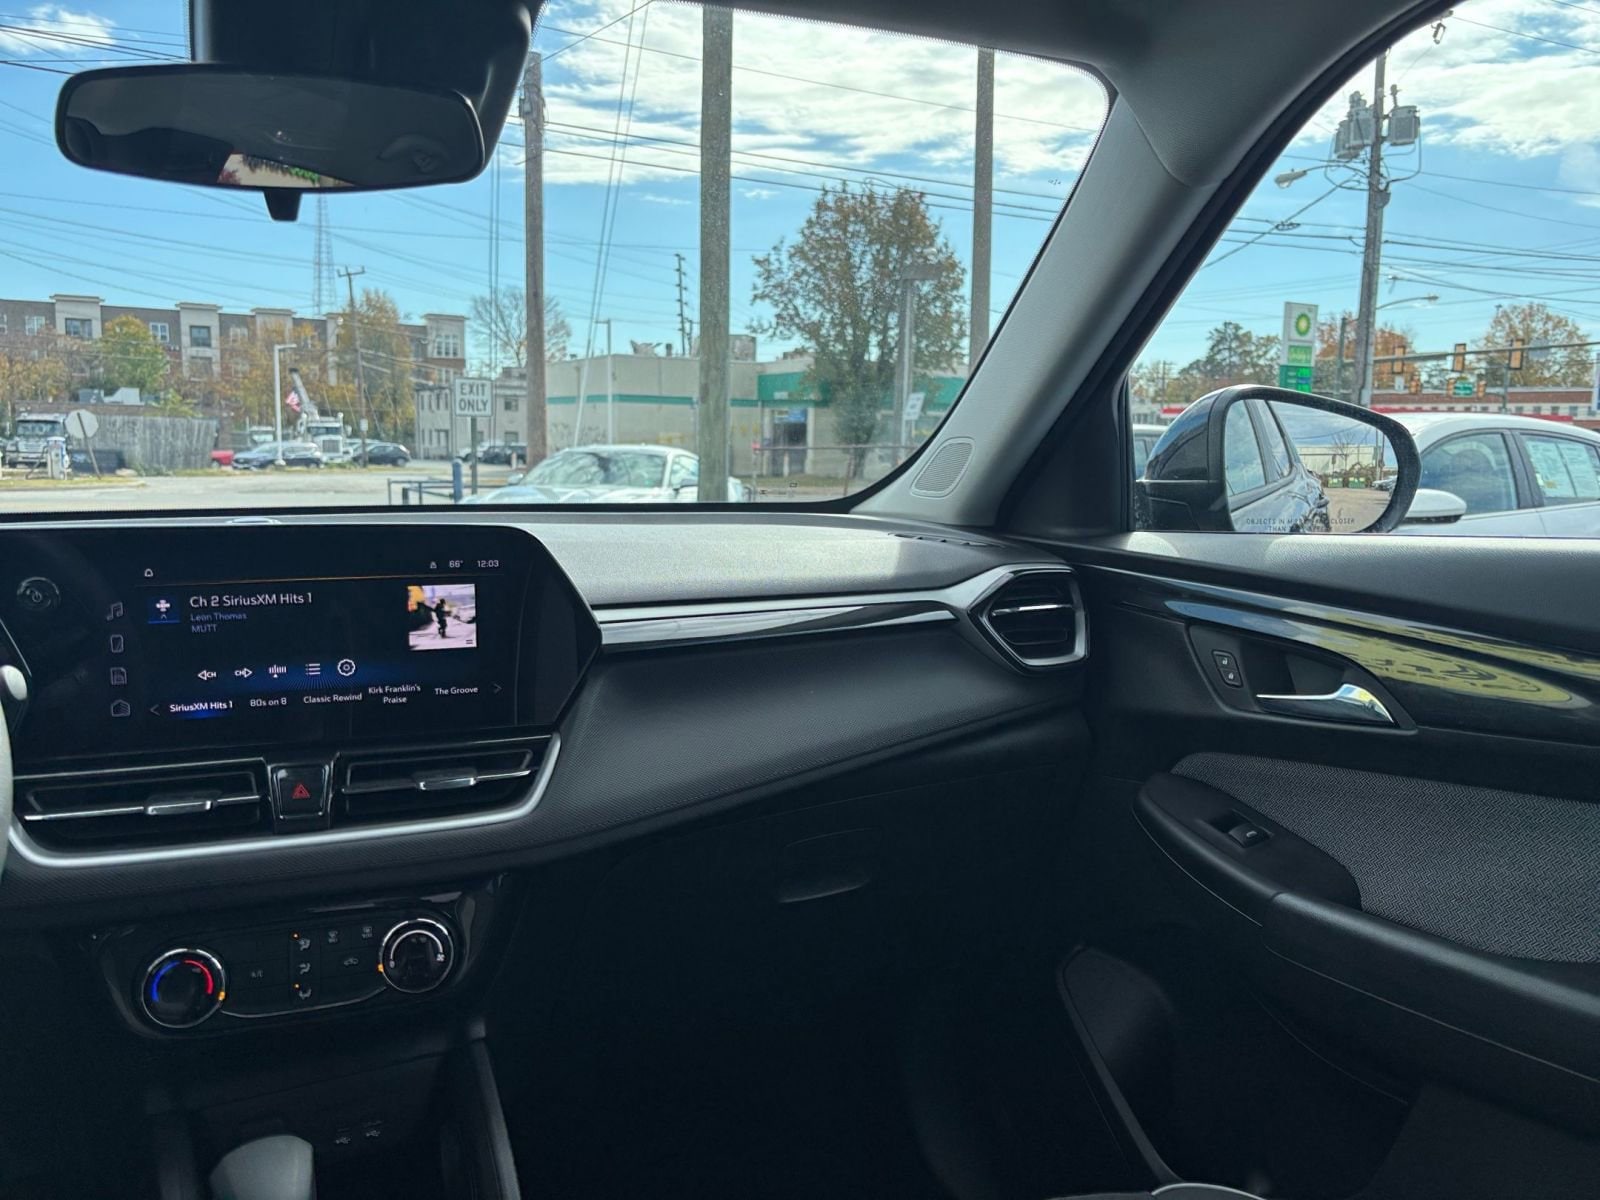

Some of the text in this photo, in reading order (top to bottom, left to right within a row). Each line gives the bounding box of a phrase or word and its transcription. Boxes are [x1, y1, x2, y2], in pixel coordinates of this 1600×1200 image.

[460, 383, 487, 396] EXIT
[459, 398, 489, 412] ONLY
[477, 559, 499, 568] 12:03
[189, 592, 312, 608] Ch 2 SiriusXM Hits 1
[190, 612, 248, 622] Leon Thomas
[191, 624, 217, 633] MUTT
[368, 683, 421, 694] Kirk Franklin's
[434, 686, 479, 695] The Groove
[249, 699, 267, 707] 80s
[281, 697, 288, 705] 8
[303, 692, 363, 704] Classic Rewind
[383, 696, 408, 704] Praise
[169, 700, 233, 712] SiriusXM Hits 1
